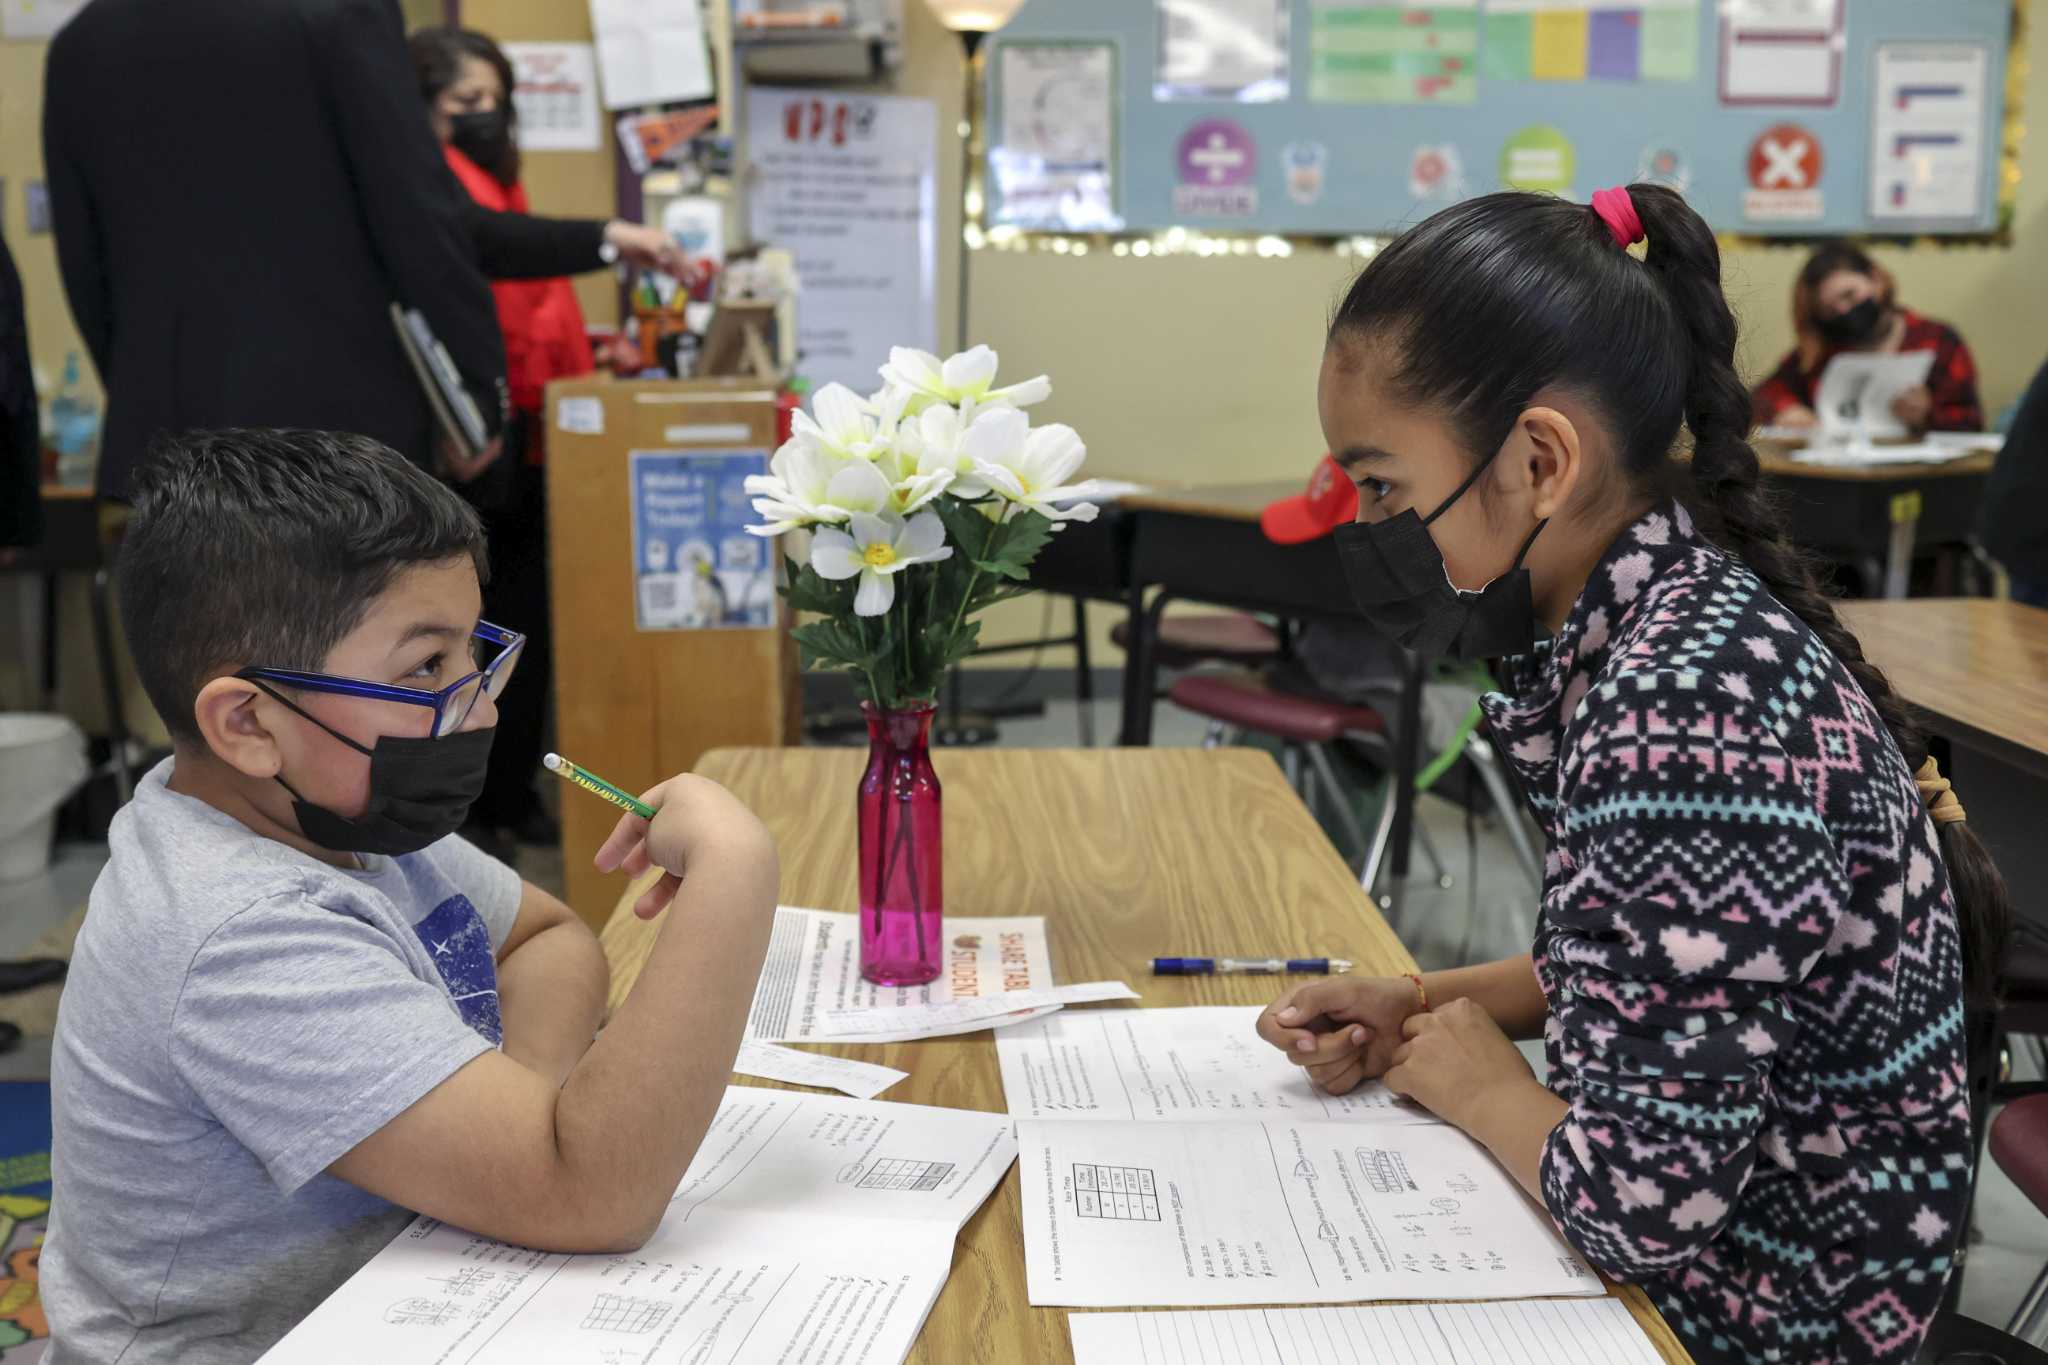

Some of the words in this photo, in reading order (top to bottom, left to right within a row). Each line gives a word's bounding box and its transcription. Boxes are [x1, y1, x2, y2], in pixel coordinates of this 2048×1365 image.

[1000, 933, 1026, 965] SHARE
[951, 950, 979, 1000] STUDENT
[1004, 966, 1030, 992] TABL
